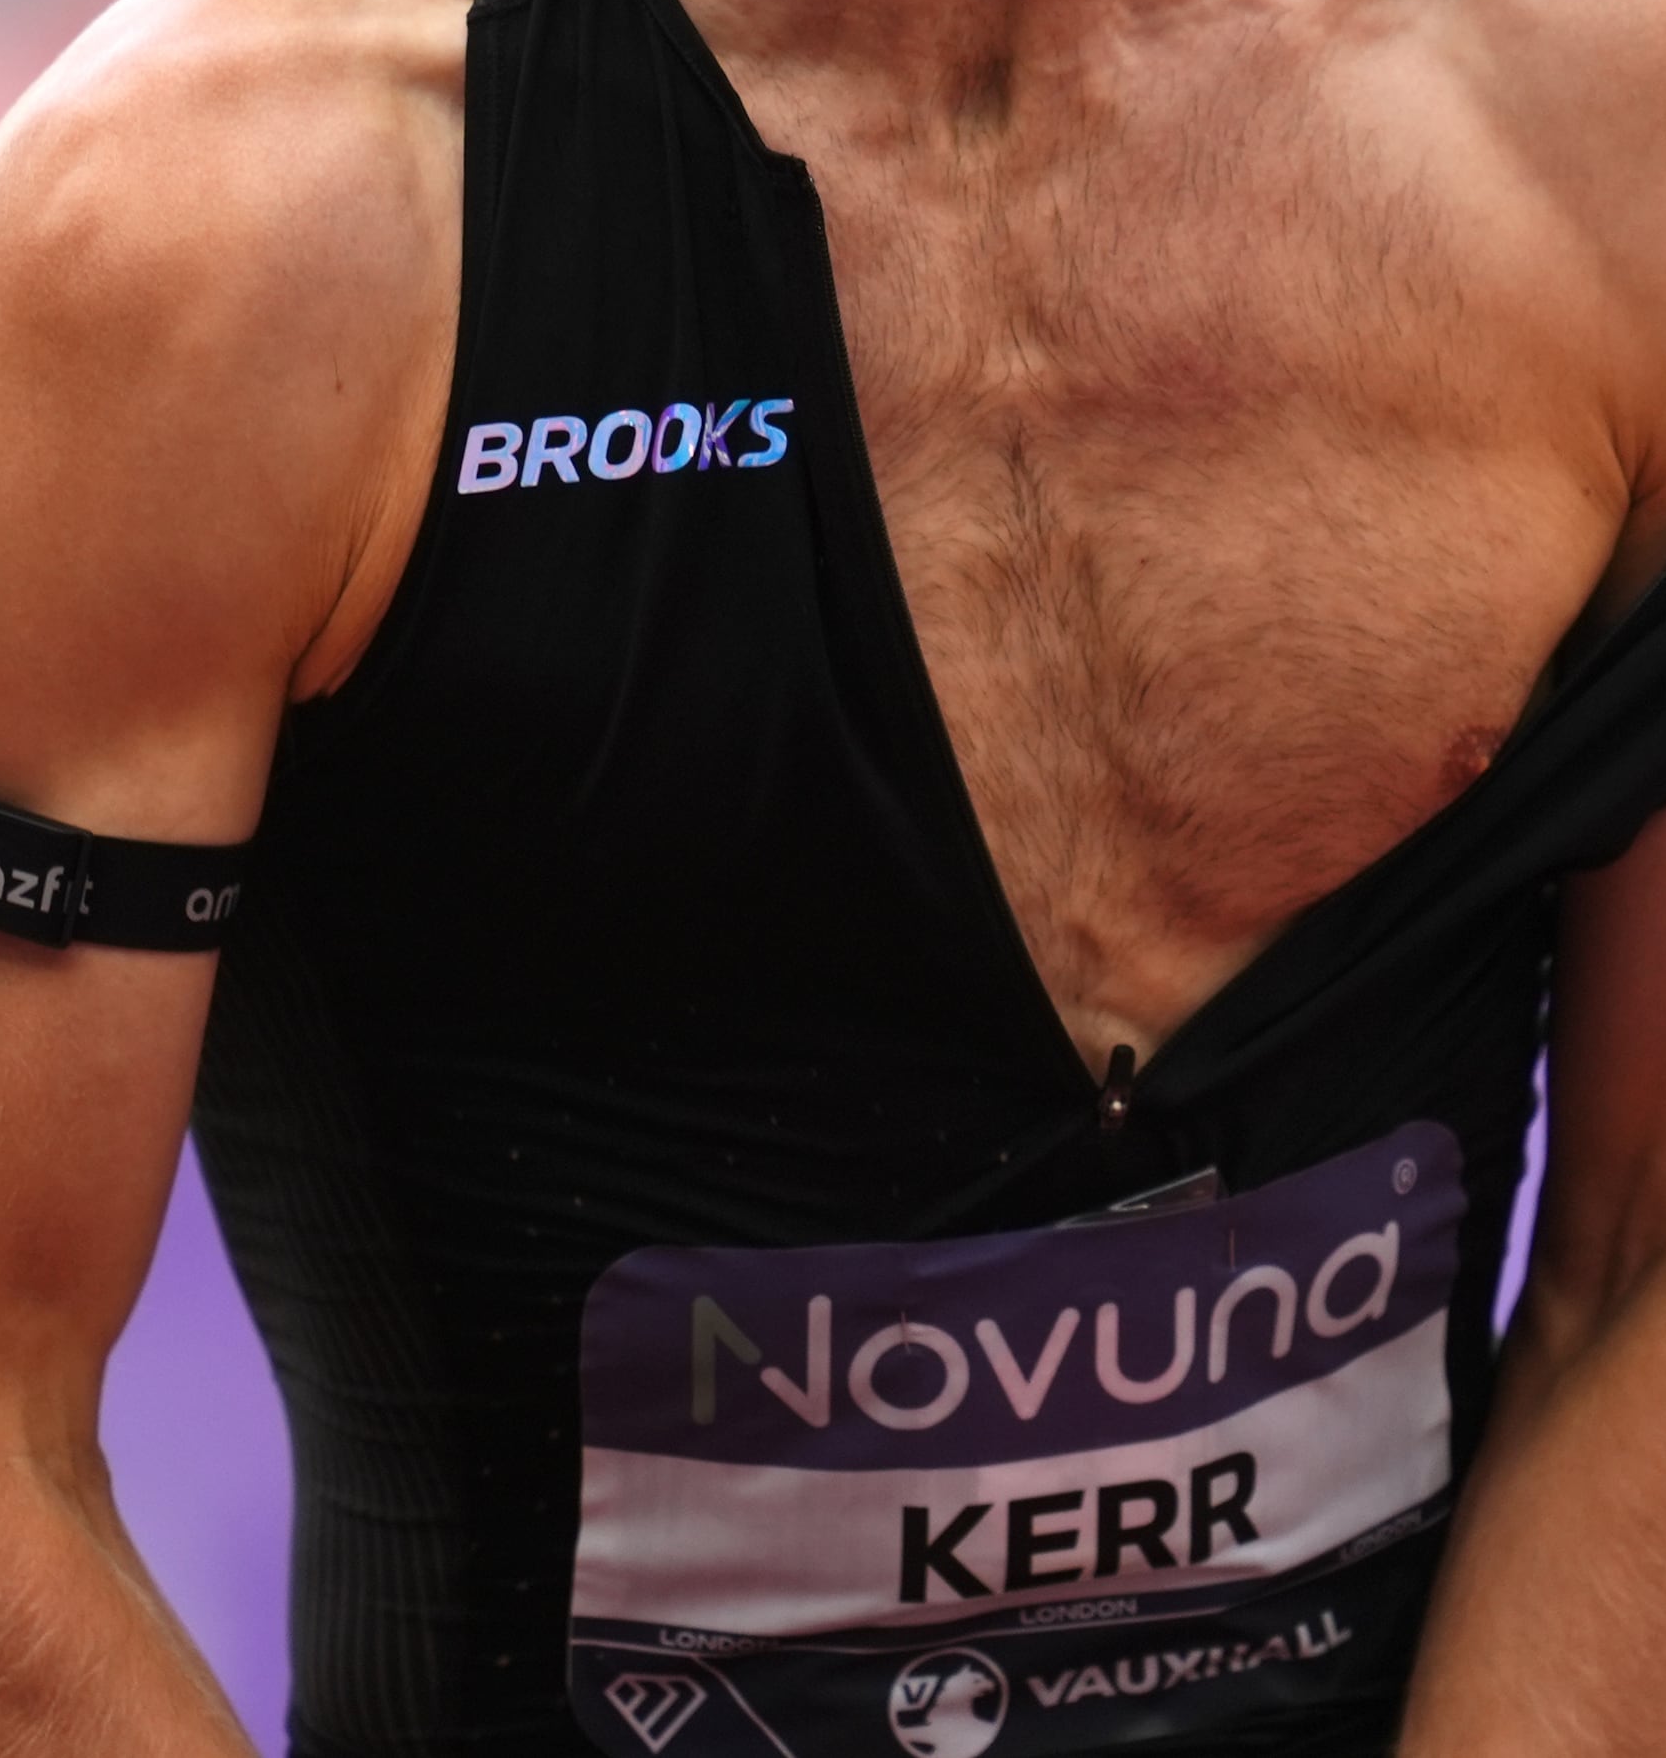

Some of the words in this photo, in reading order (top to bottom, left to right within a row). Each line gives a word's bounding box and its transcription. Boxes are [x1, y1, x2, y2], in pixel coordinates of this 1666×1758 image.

[456, 398, 795, 496] BROOKS
[897, 1450, 1261, 1605] KERR
[1018, 1593, 1139, 1629] LONDON
[1027, 1608, 1354, 1709] VAUXHALL
